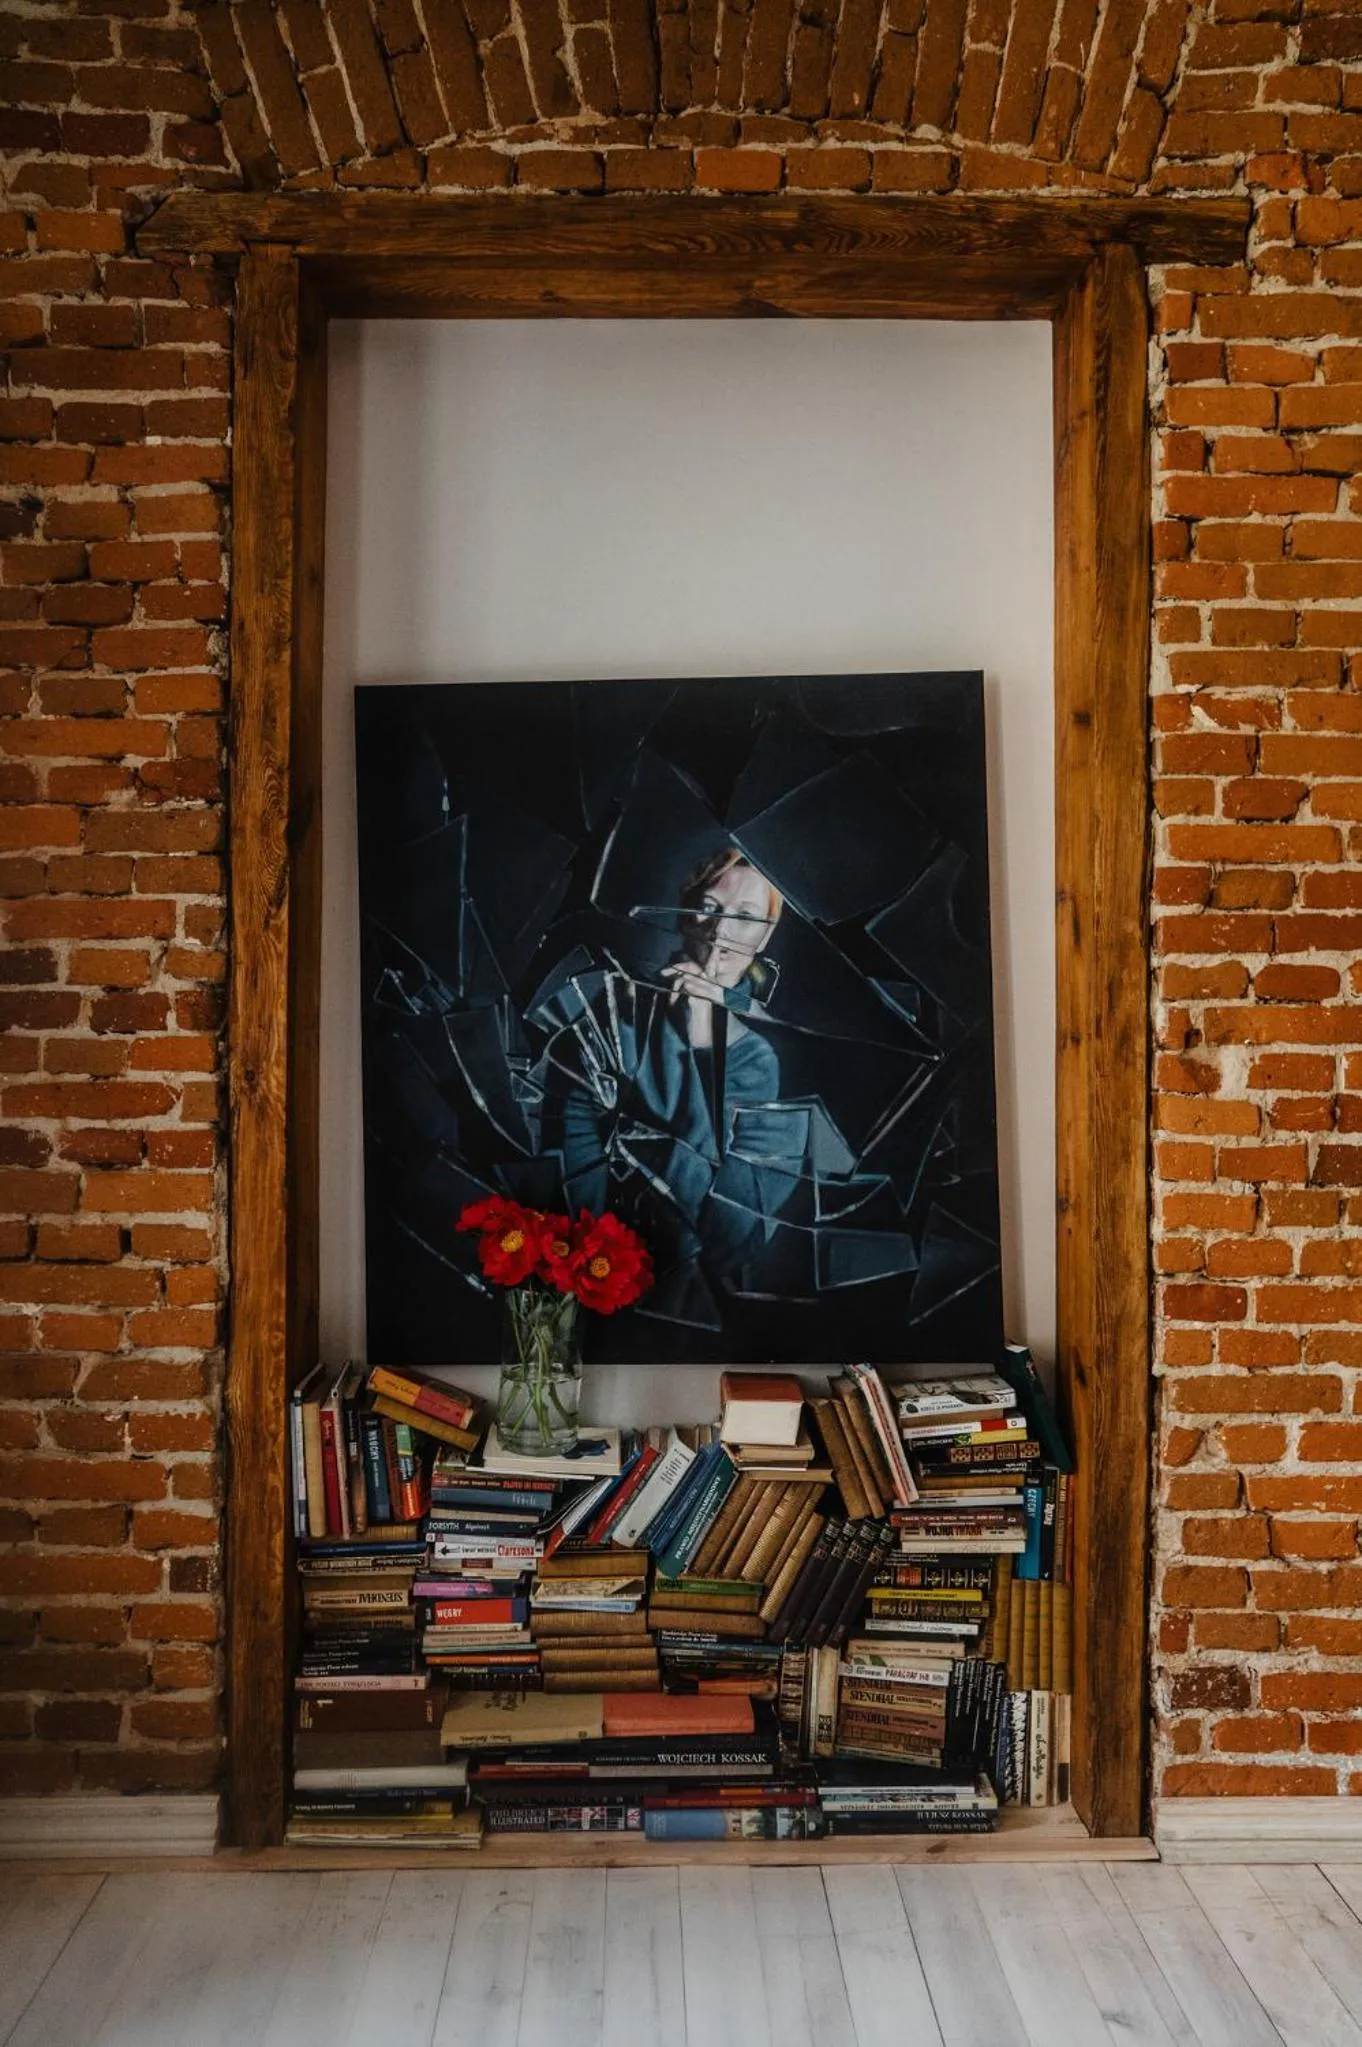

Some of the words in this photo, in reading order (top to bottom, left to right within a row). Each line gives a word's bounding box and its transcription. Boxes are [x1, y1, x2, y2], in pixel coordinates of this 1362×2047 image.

[428, 1522, 460, 1532] FORSYTH
[359, 1591, 403, 1604] STENDHAL
[436, 1607, 463, 1620] WĘGRY
[885, 1669, 918, 1680] PARAGRAF
[850, 1689, 896, 1704] STENDHAL
[657, 1752, 717, 1765] WOJCIECH
[721, 1752, 768, 1764] KOSSAK
[489, 1816, 546, 1826] ILLUSTRATED
